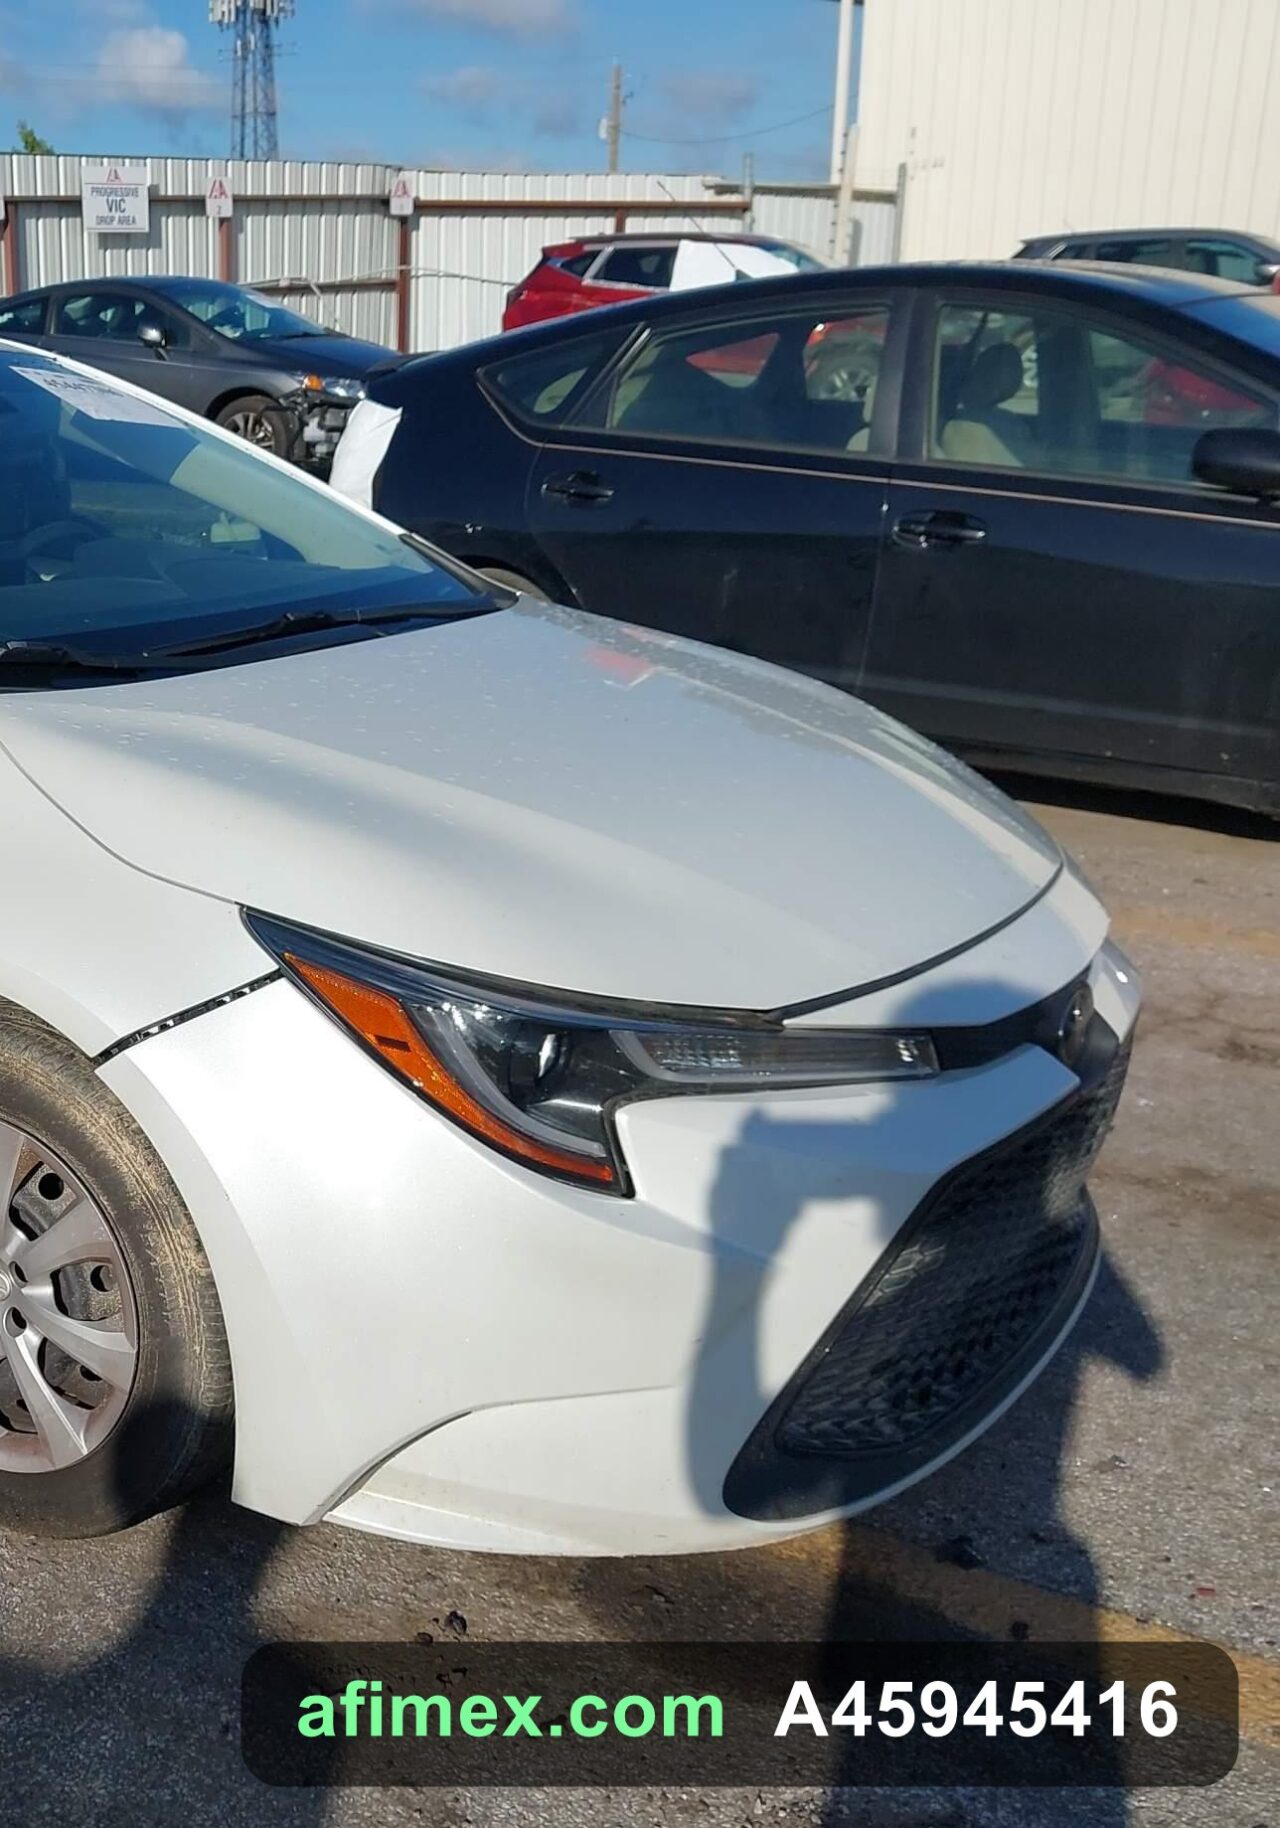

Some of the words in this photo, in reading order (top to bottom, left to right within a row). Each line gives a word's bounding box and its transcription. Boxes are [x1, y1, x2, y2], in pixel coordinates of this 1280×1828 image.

[90, 187, 139, 197] PROGRESSIVE
[106, 198, 126, 213] VIC
[95, 215, 116, 226] DROP
[117, 215, 137, 226] AREA
